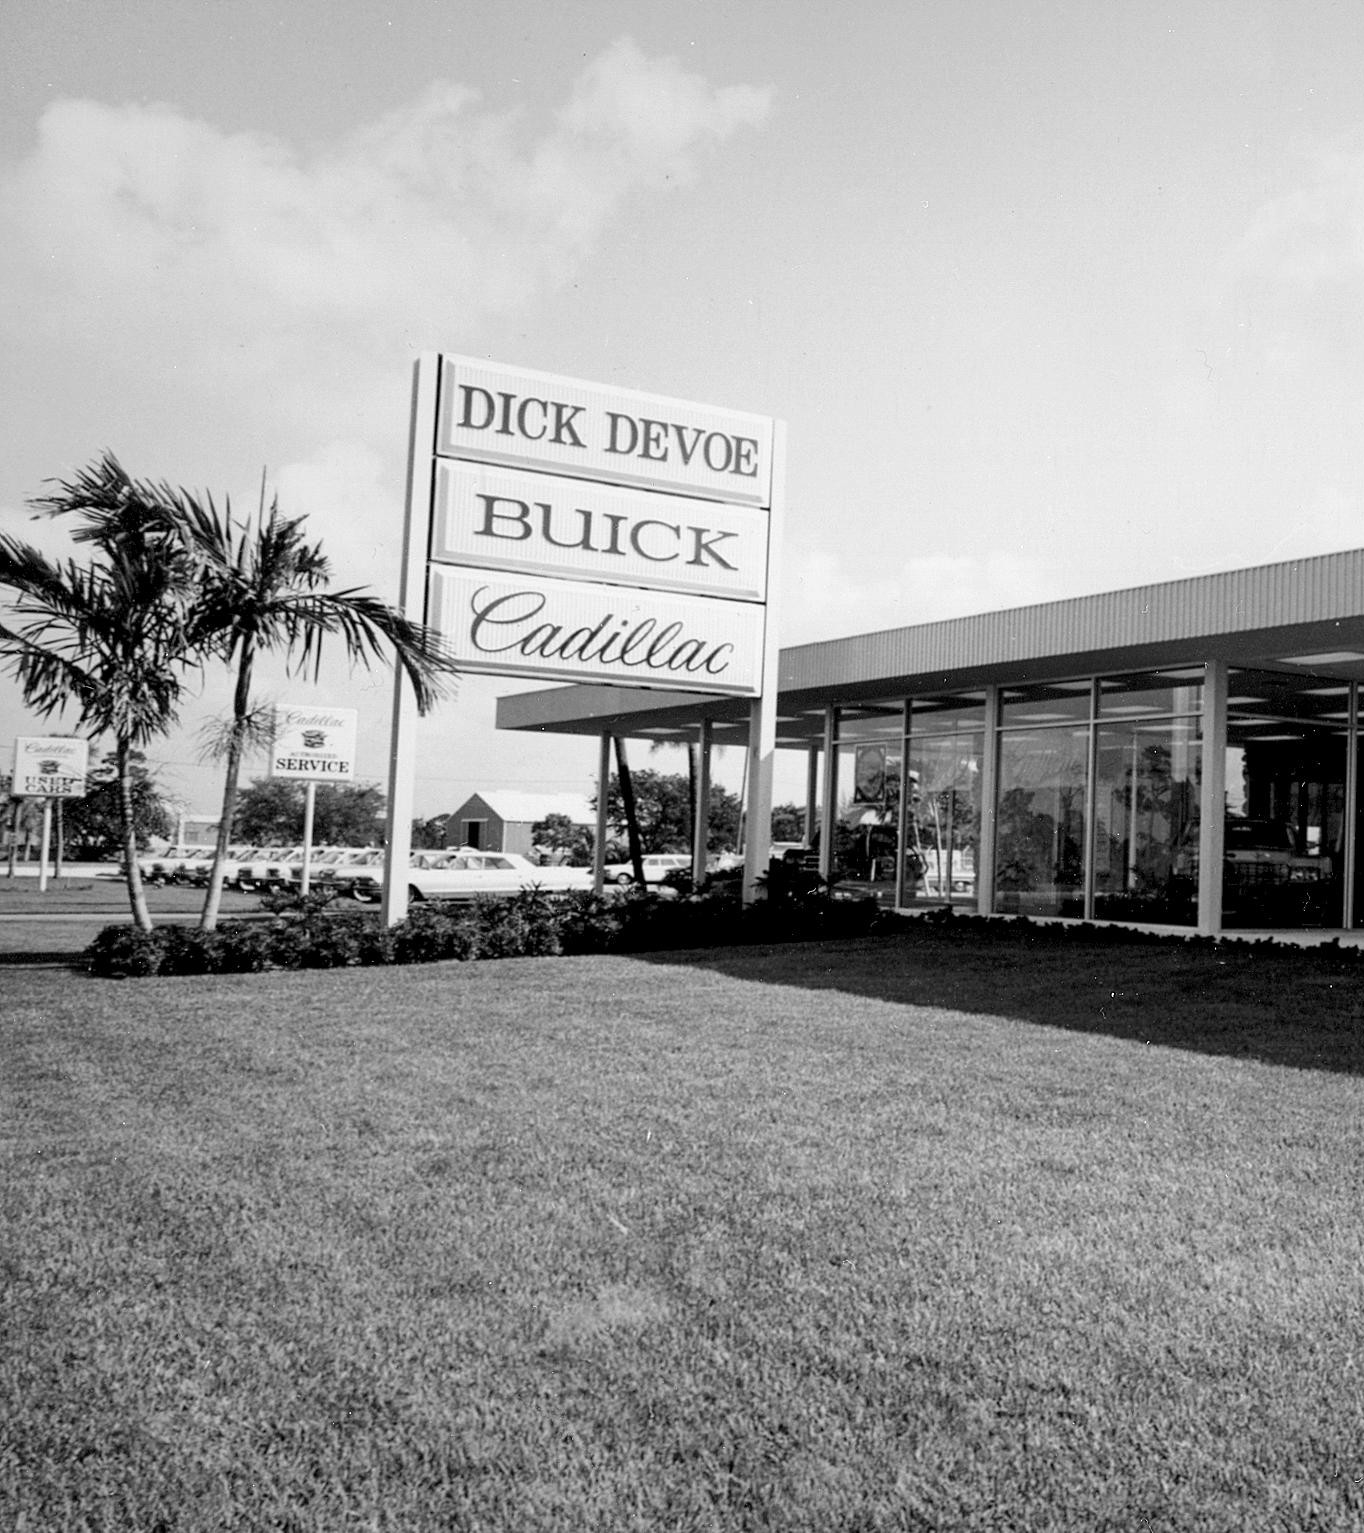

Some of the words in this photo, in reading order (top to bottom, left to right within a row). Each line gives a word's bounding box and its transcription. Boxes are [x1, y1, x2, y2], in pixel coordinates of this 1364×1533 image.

[457, 384, 587, 448] DICK
[604, 411, 759, 477] DEVOE
[474, 493, 739, 571] BUICK
[471, 586, 734, 674] Cadillac
[286, 711, 344, 727] Cadillac
[26, 785, 72, 793] CARS
[275, 758, 350, 773] SERVICE
